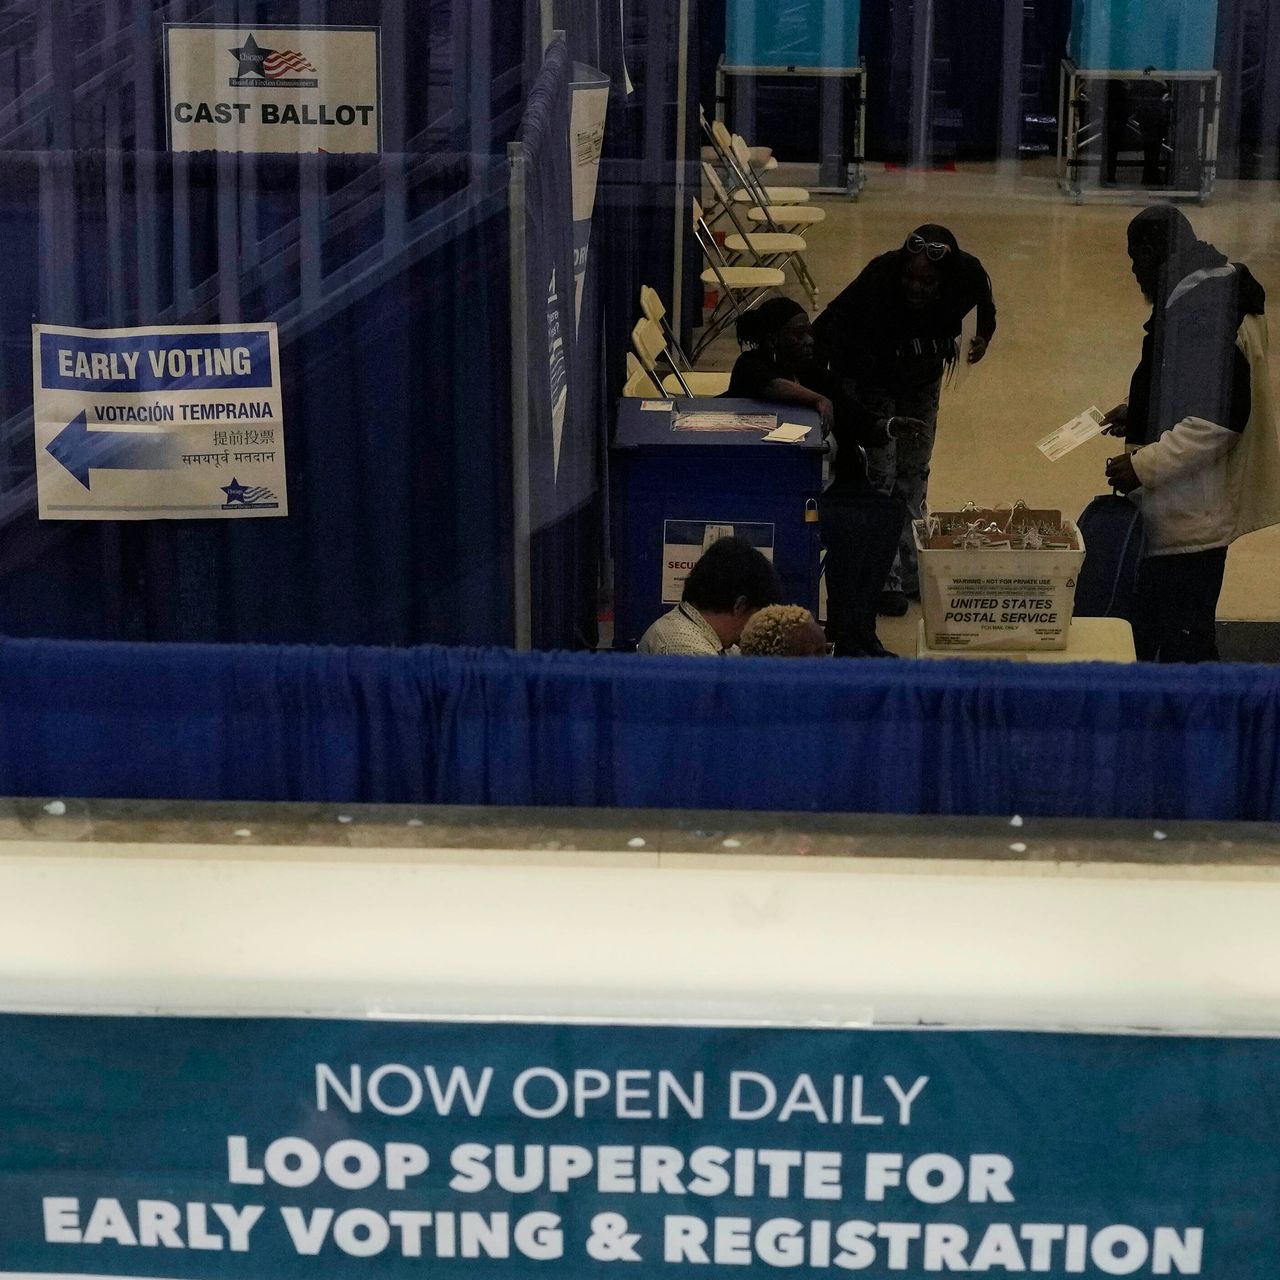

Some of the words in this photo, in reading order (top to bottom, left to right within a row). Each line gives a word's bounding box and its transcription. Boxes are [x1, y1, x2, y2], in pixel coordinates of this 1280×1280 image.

[239, 52, 264, 63] Chicago
[174, 102, 251, 124] CAST
[261, 103, 374, 126] BALLOT
[57, 349, 140, 380] EARLY
[148, 347, 252, 379] VOTING
[94, 402, 174, 422] VOTACIÓN
[179, 402, 274, 421] TEMPRANA
[213, 430, 275, 447] 提前投票
[181, 450, 230, 468] समयपूर्व
[234, 451, 276, 463] मतदान
[950, 599, 999, 609] UNITED
[1001, 599, 1053, 609] STATES
[944, 612, 996, 623] POSTAL
[1000, 613, 1058, 623] SERVICE
[316, 1063, 493, 1116] NOW
[513, 1067, 703, 1118] OPEN
[730, 1071, 928, 1125] DAILY
[228, 1136, 429, 1189] LOOP
[450, 1143, 842, 1199] SUPERSITE
[865, 1153, 1014, 1203] FOR
[43, 1197, 265, 1251] EARLY
[280, 1207, 563, 1260] VOTING
[586, 1212, 641, 1261] &
[664, 1215, 1203, 1275] REGISTRATION
